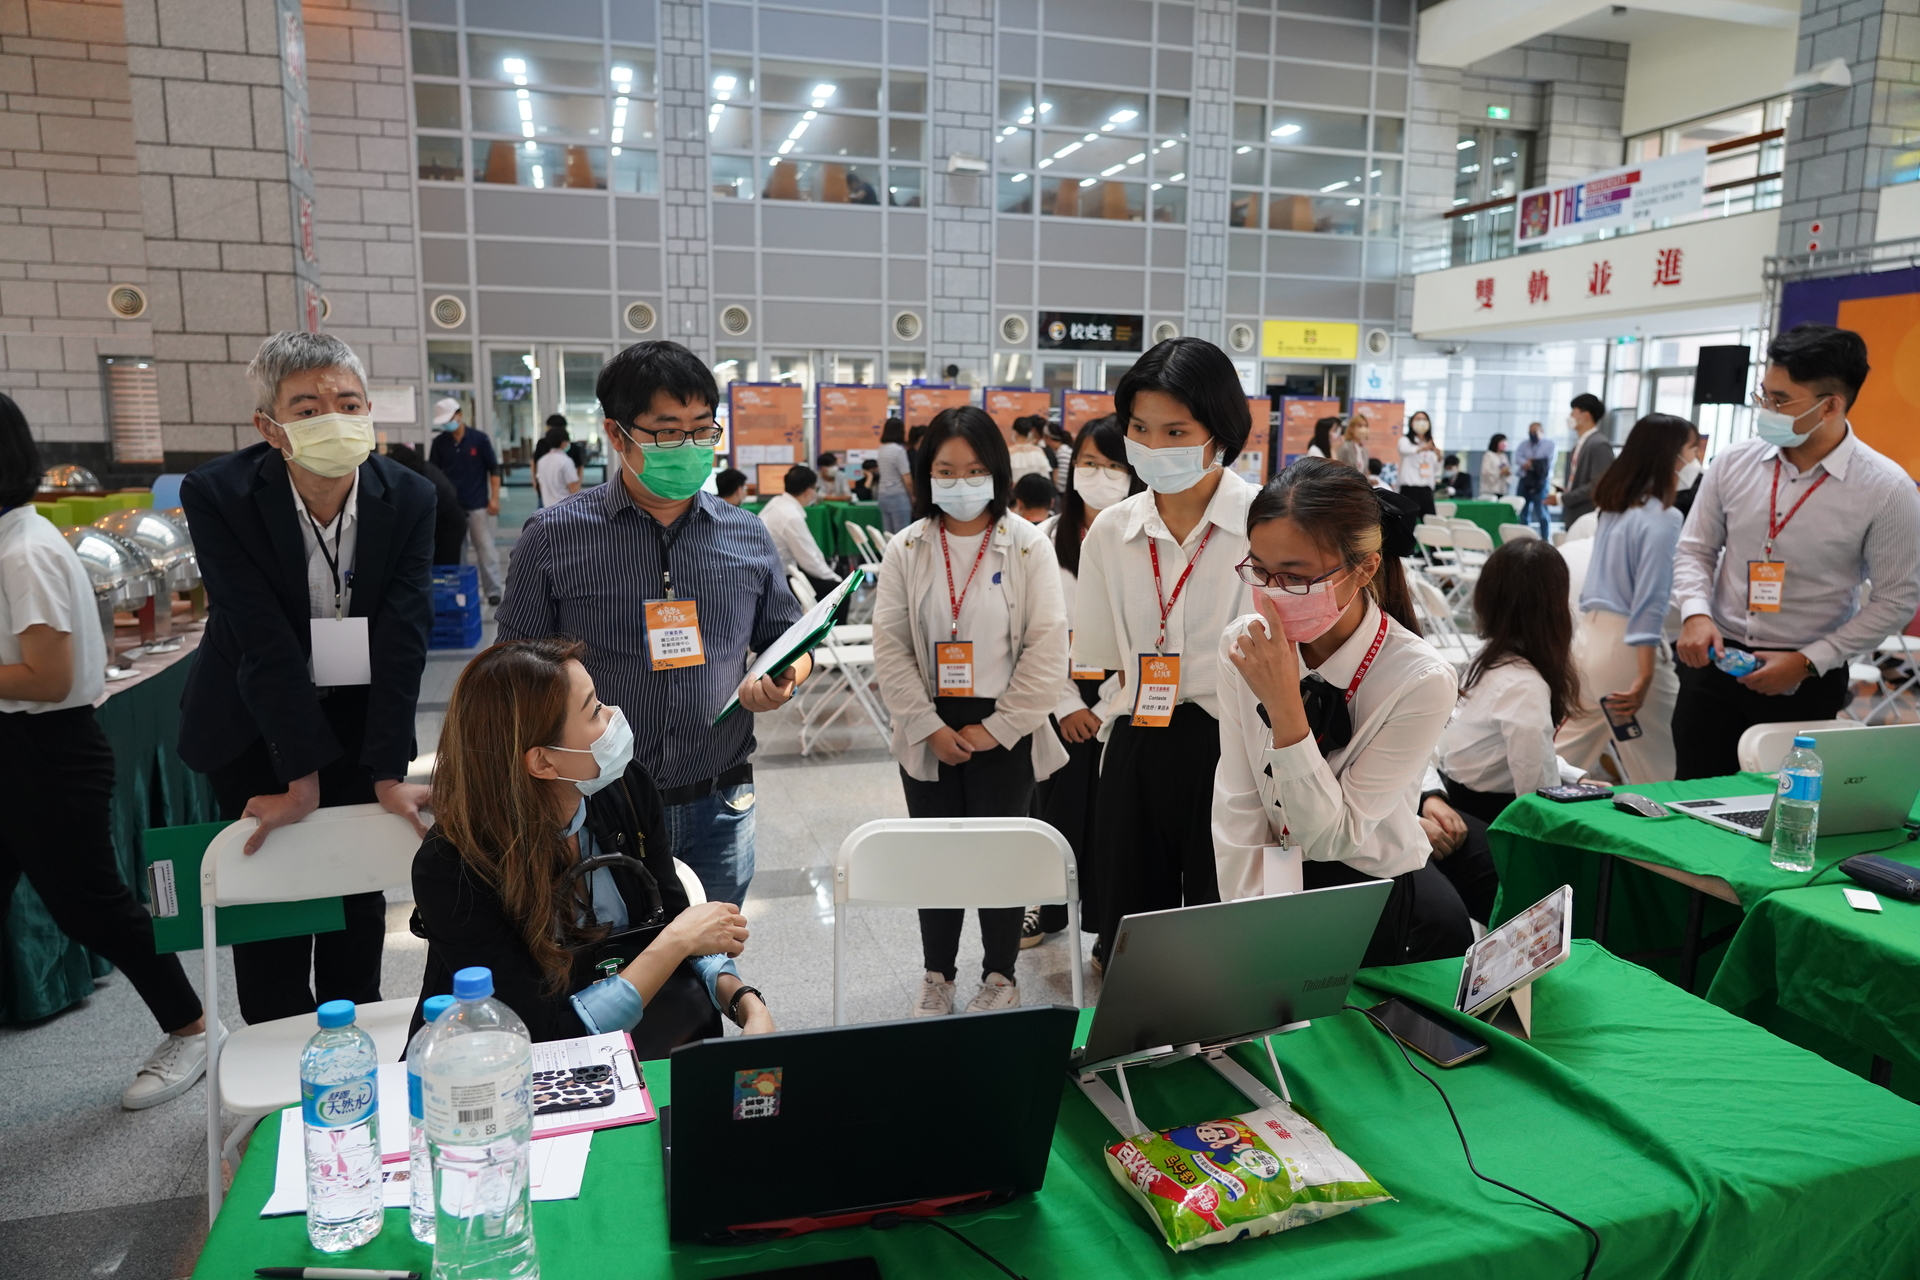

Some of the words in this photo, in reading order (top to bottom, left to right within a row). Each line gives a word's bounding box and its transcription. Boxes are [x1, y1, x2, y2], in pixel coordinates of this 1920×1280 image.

[1554, 183, 1584, 227] THE
[1070, 322, 1113, 341] 校史室
[1843, 776, 1867, 785] acer
[1301, 974, 1349, 993] ThinkBook
[327, 1093, 367, 1116] 天然水
[1264, 1119, 1292, 1140] 乖乖
[1164, 1154, 1197, 1184] 造句包
